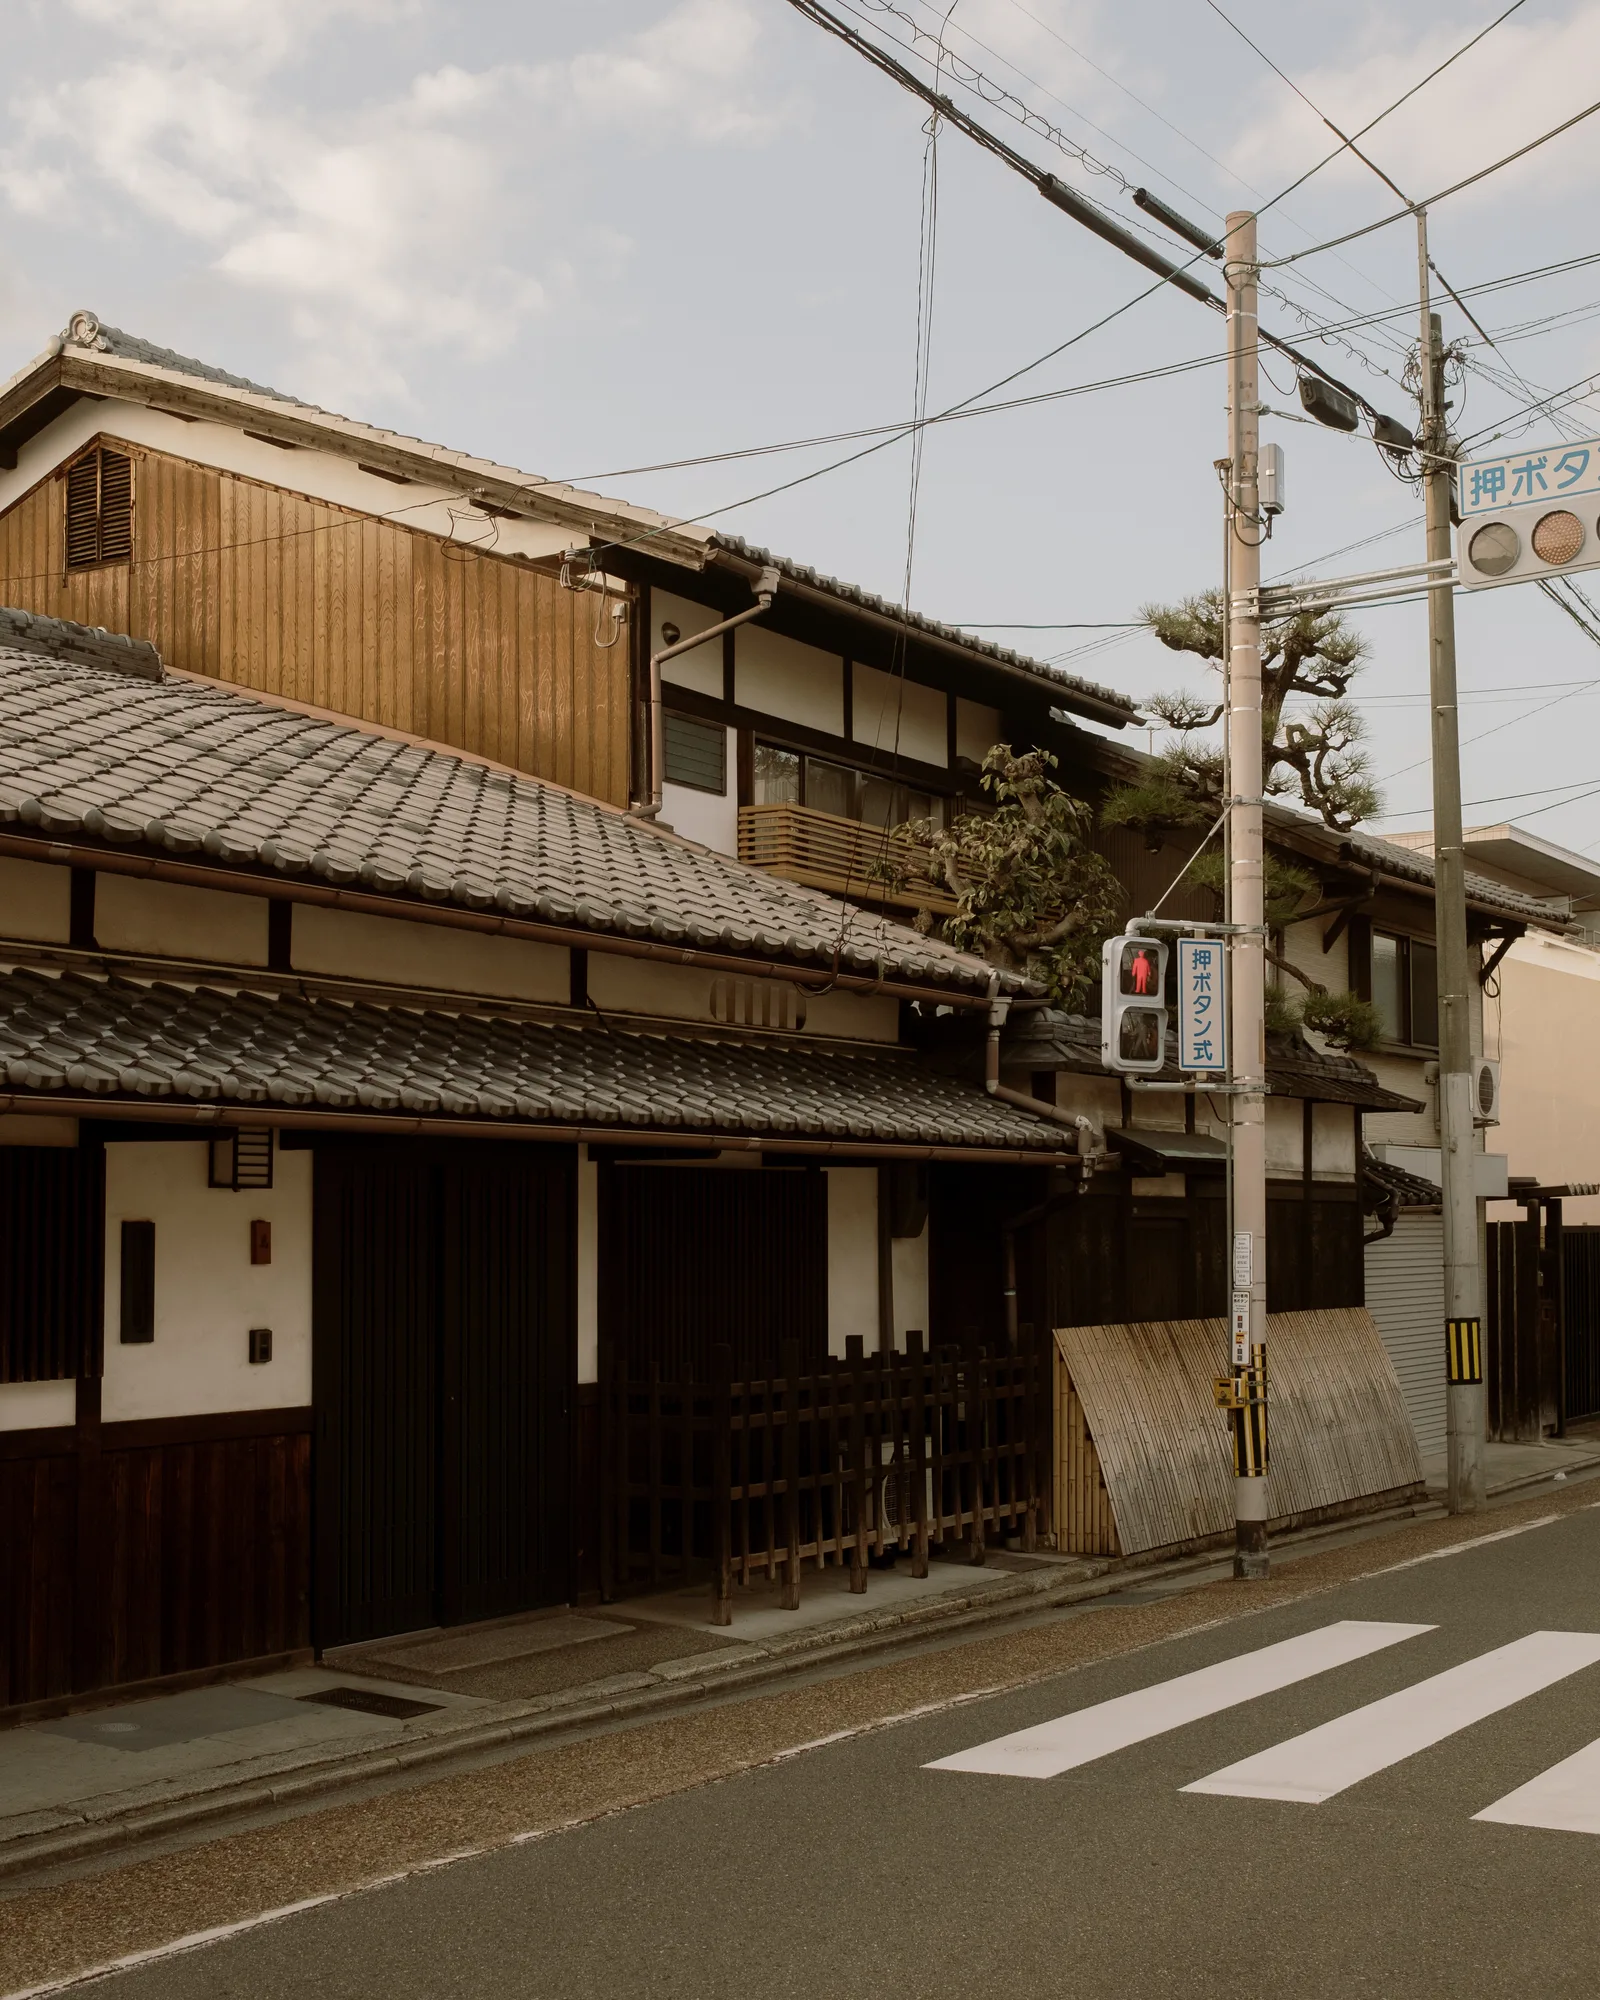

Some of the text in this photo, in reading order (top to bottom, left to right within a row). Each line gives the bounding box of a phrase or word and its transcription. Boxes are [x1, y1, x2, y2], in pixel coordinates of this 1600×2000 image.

[1470, 449, 1600, 506] 押ボタ
[1192, 949, 1213, 1061] 押ボタン式
